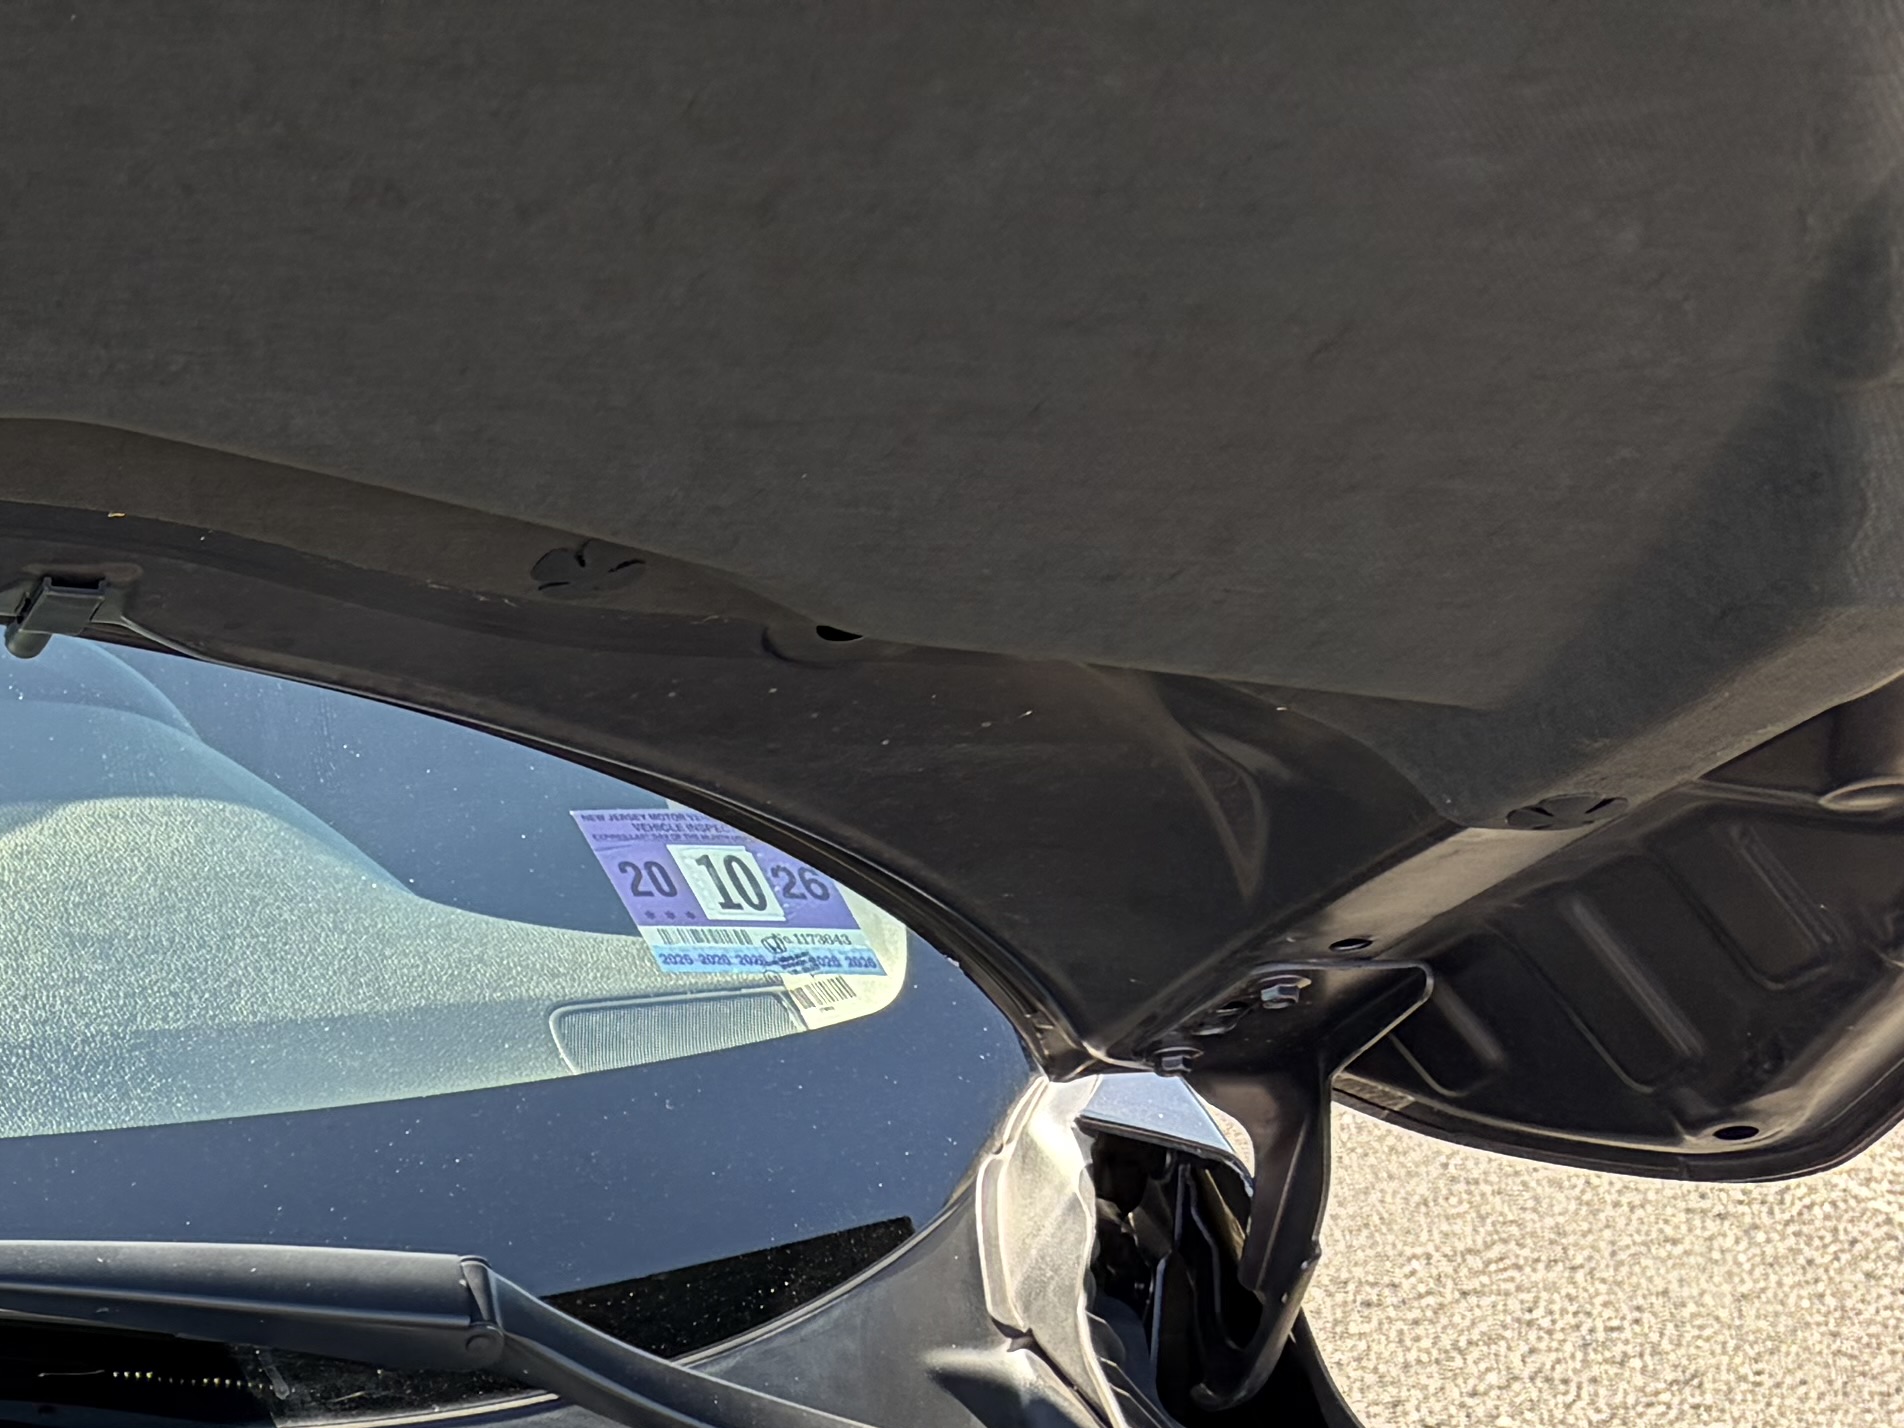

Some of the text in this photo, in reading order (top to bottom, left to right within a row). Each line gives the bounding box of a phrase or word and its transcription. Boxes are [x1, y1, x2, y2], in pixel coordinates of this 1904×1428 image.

[632, 822, 684, 833] VEHICLE
[618, 854, 831, 911] 20 10 26
